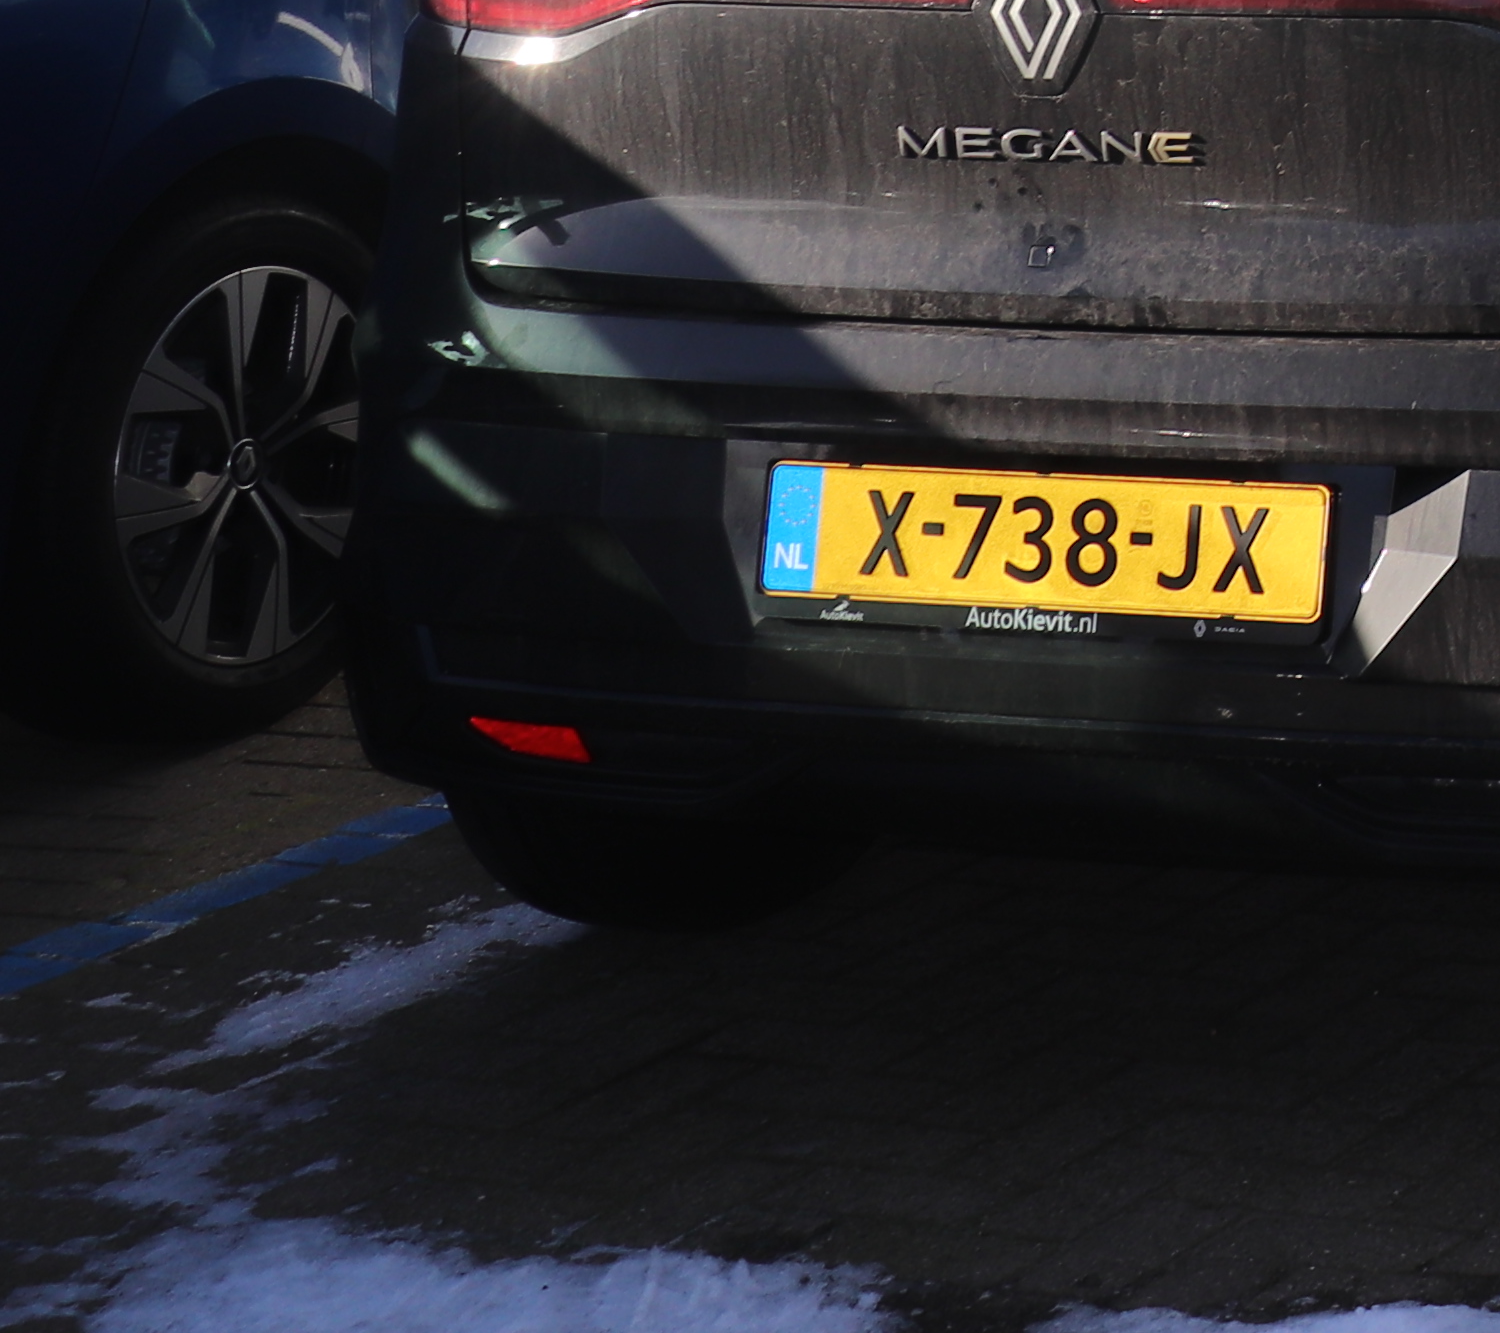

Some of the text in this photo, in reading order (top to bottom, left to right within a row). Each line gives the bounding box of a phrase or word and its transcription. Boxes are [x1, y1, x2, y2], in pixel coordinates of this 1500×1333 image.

[897, 125, 1194, 164] MEGANE
[773, 542, 809, 571] NL
[859, 490, 1270, 595] X-738-JX
[965, 606, 1098, 634] AutoKievit.nl
